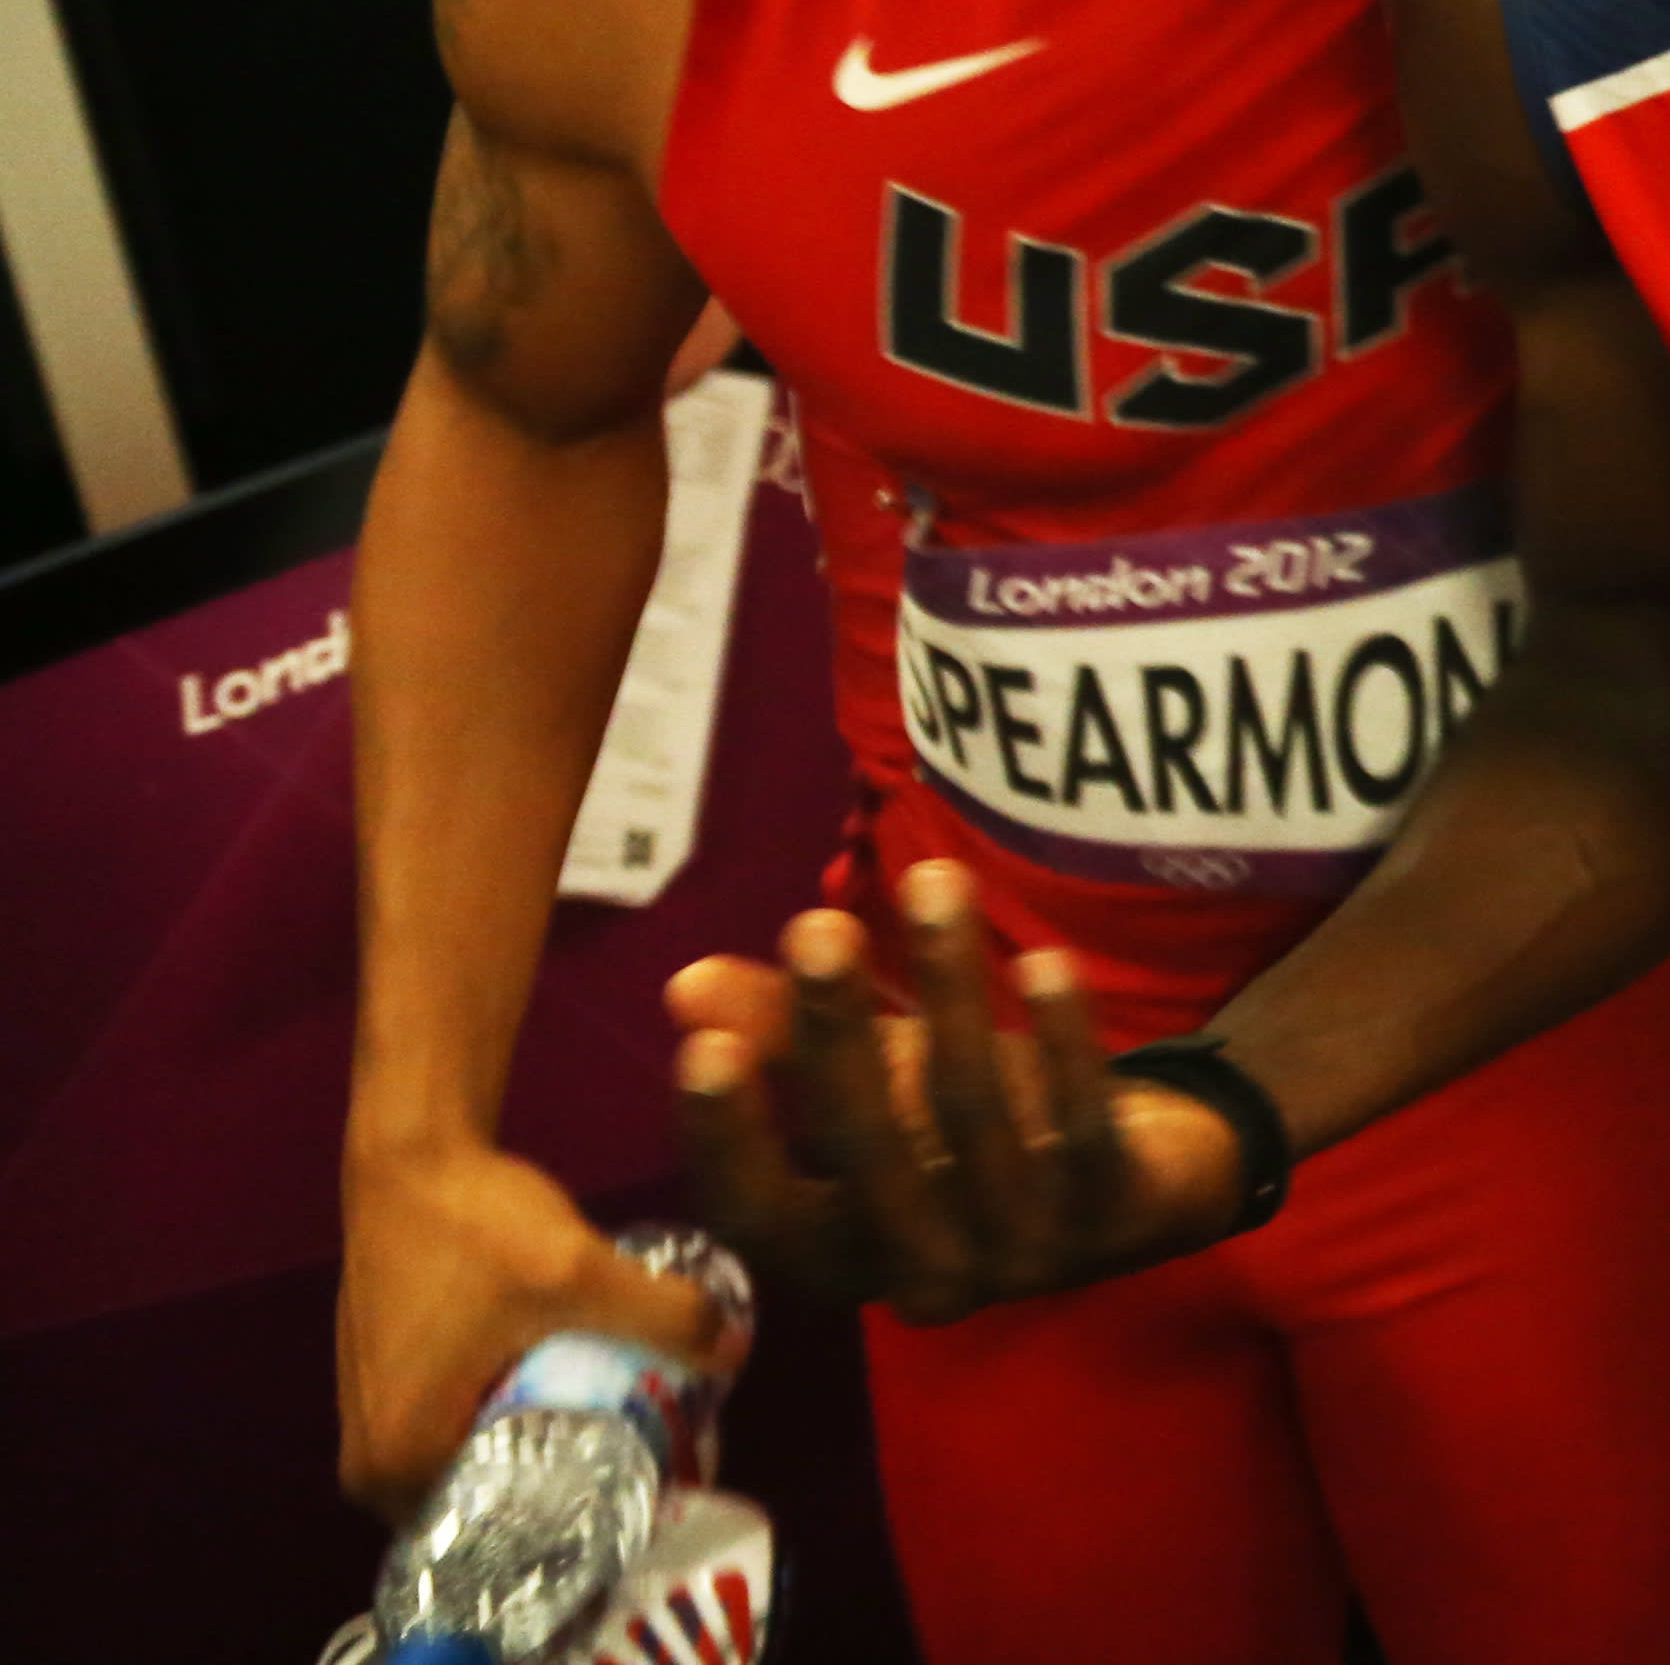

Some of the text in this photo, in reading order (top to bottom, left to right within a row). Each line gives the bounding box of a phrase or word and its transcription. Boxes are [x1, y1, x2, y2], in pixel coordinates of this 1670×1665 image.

[965, 532, 1375, 617] London 2012
[180, 608, 350, 737] Lond
